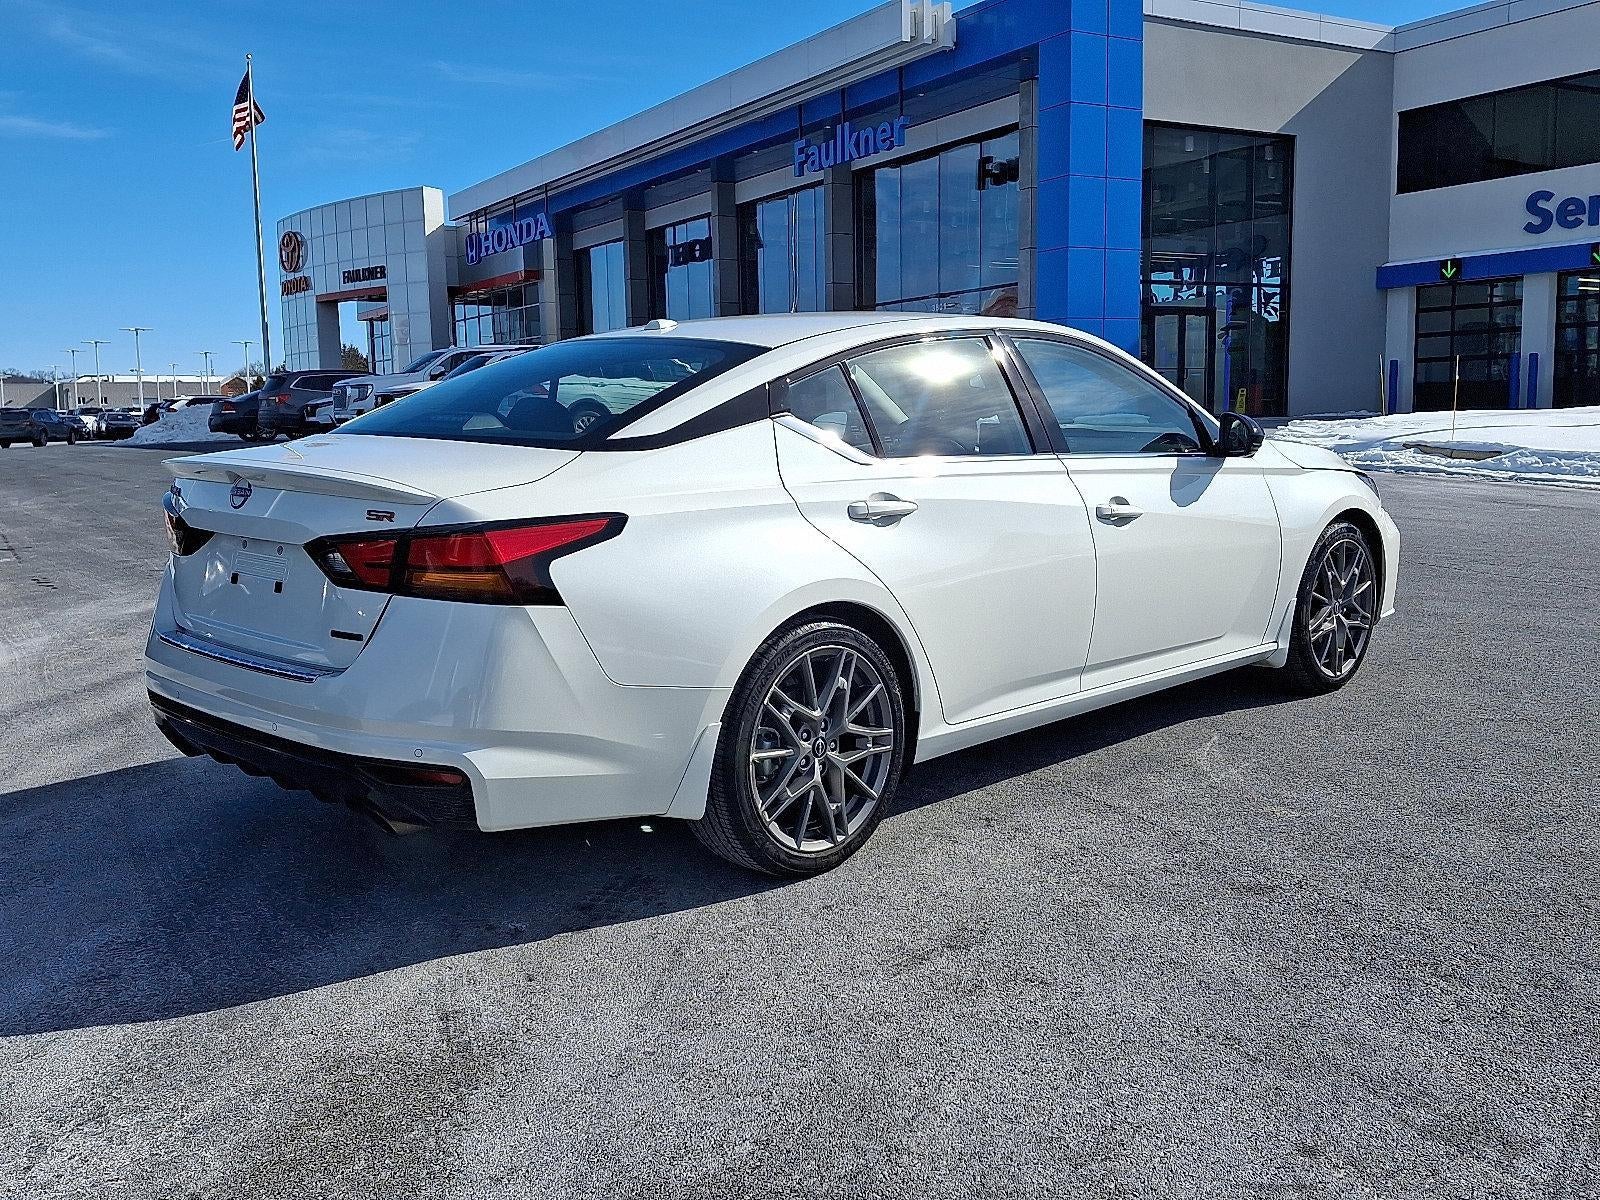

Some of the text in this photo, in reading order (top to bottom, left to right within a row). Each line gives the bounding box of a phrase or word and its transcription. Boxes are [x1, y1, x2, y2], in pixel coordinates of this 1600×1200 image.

[794, 116, 911, 177] Faulkner
[480, 212, 552, 257] HONDA
[342, 265, 387, 284] FAULKNER
[281, 276, 312, 296] TOYOTA
[366, 509, 395, 523] SR
